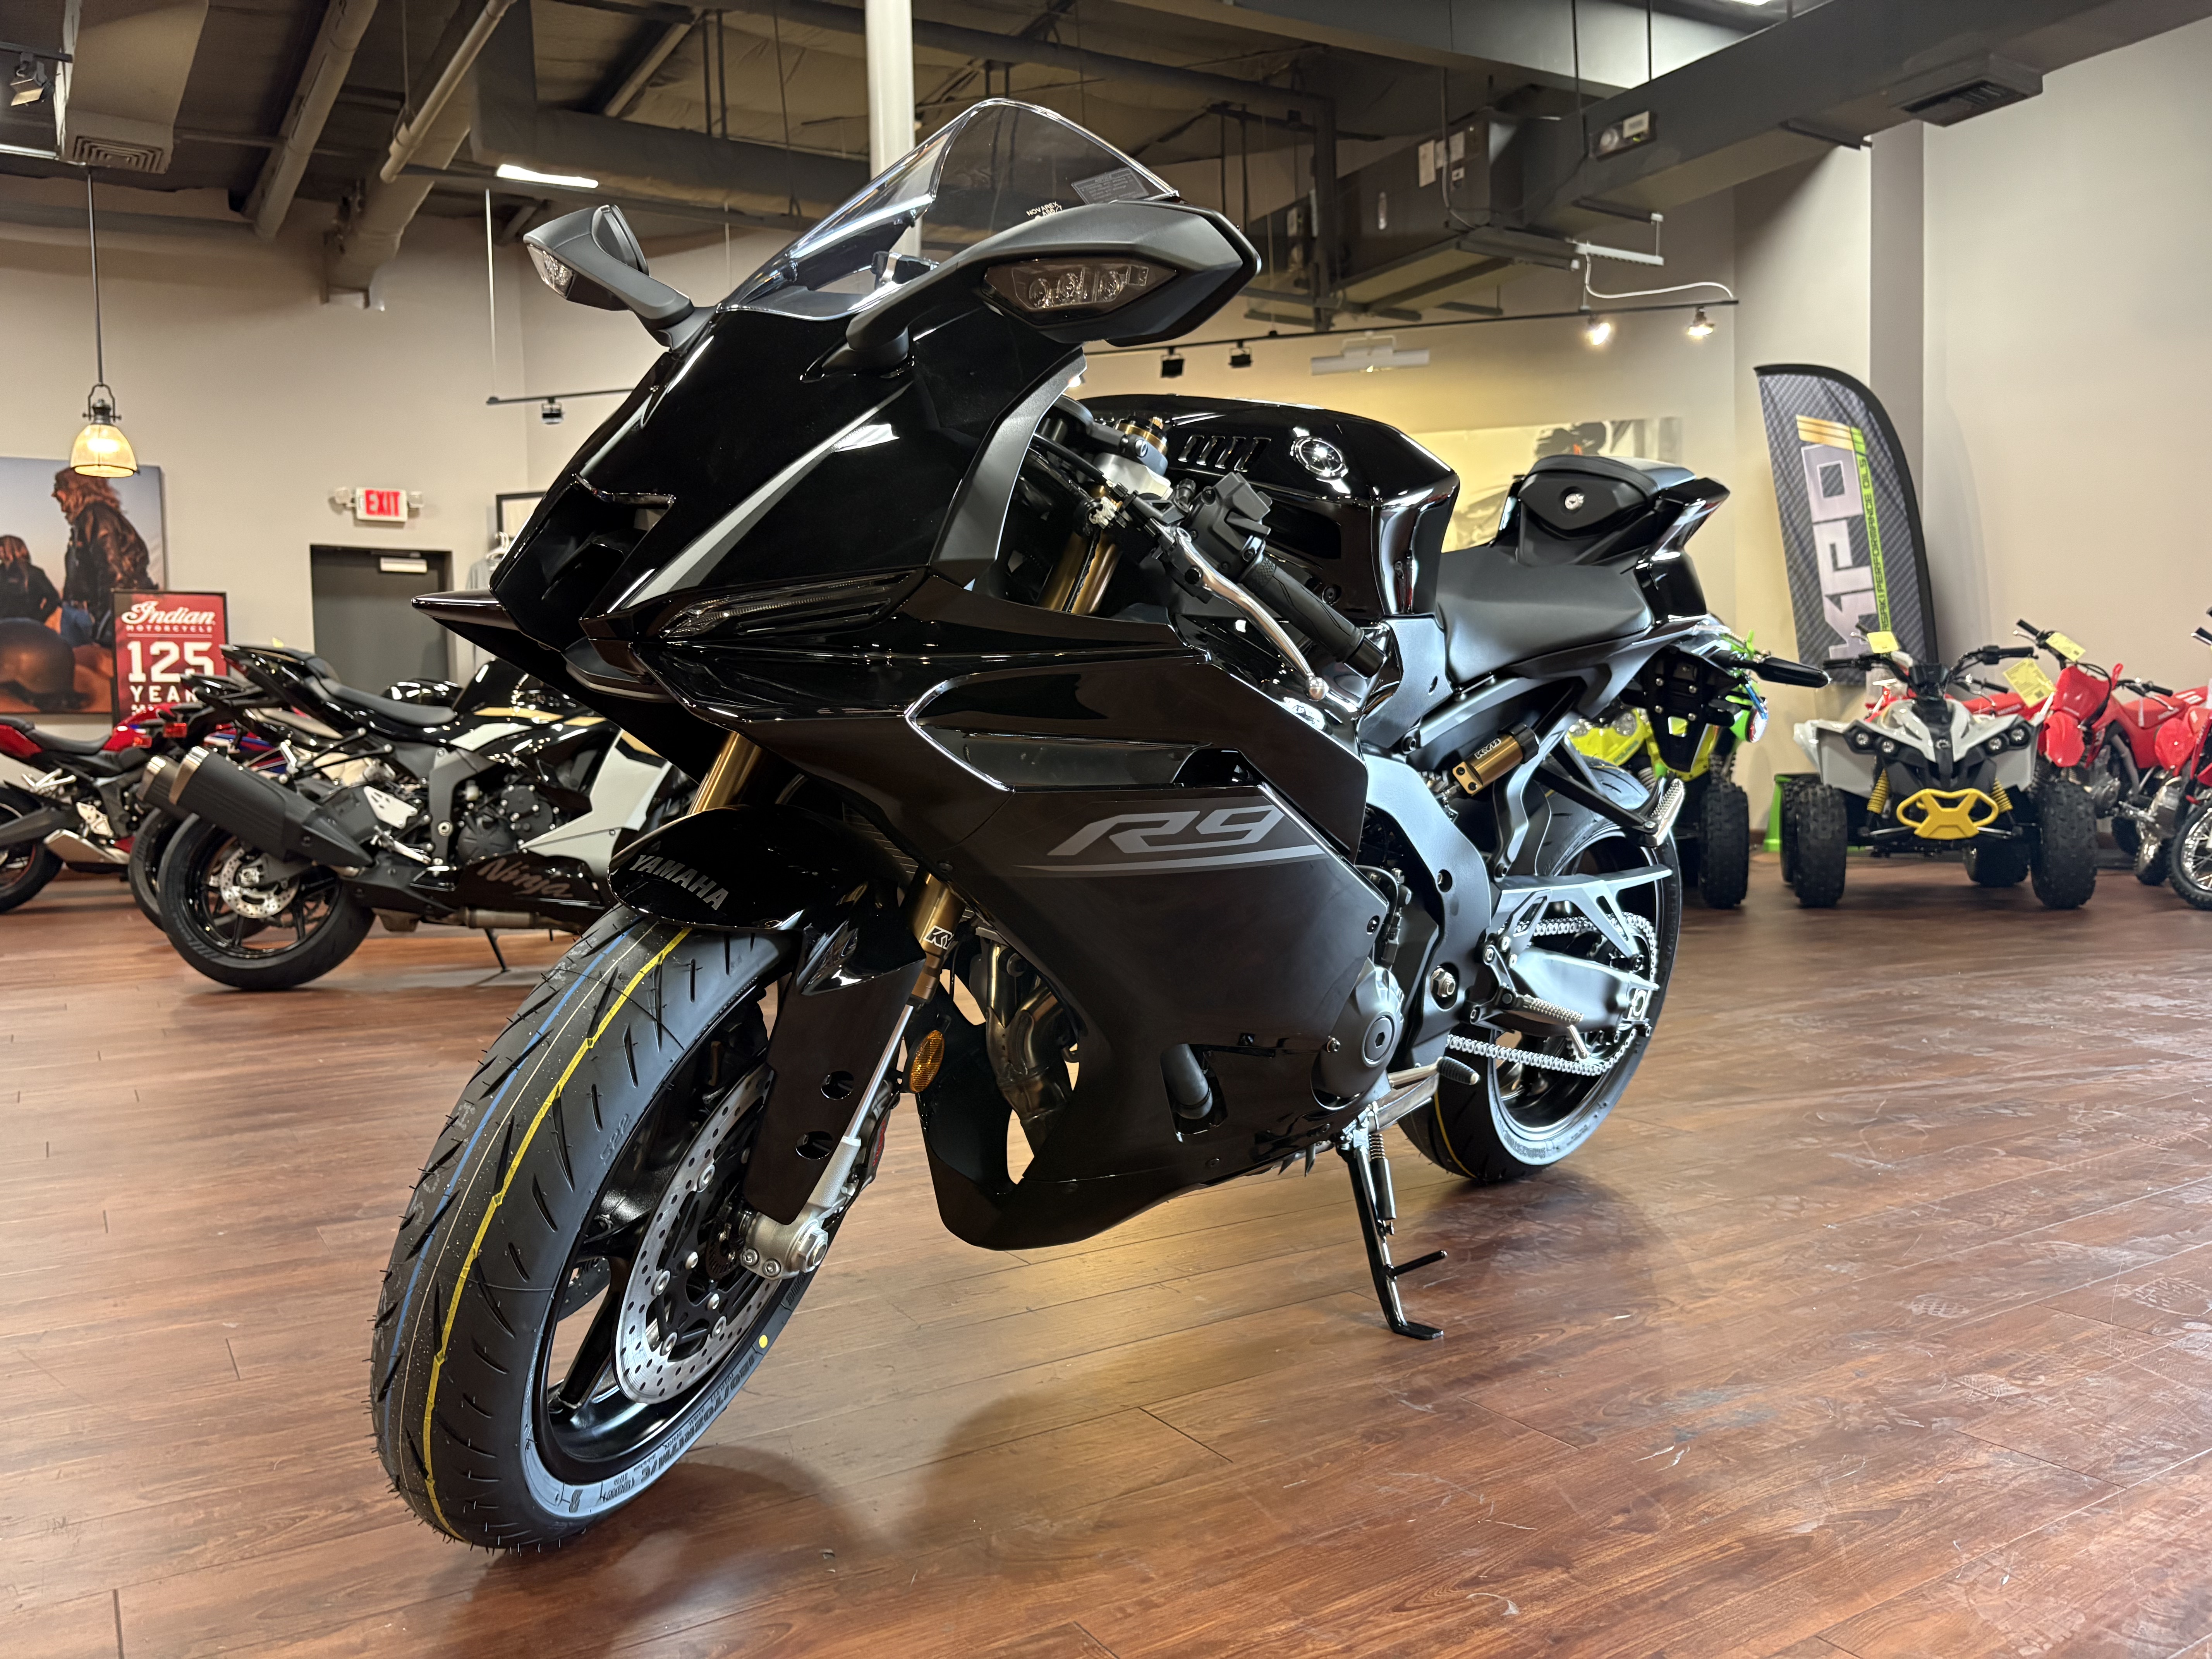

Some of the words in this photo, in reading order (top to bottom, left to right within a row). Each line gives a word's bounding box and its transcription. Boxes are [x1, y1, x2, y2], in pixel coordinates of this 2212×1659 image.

[1026, 201, 1059, 216] NOVAREX
[1859, 459, 1870, 489] OILS
[365, 489, 400, 517] EXIT
[121, 601, 215, 625] Indian
[127, 641, 214, 683] 125
[1047, 805, 1285, 856] R9
[477, 857, 573, 897] Ninja
[629, 855, 729, 910] YAMAHA
[600, 1113, 632, 1166] S22
